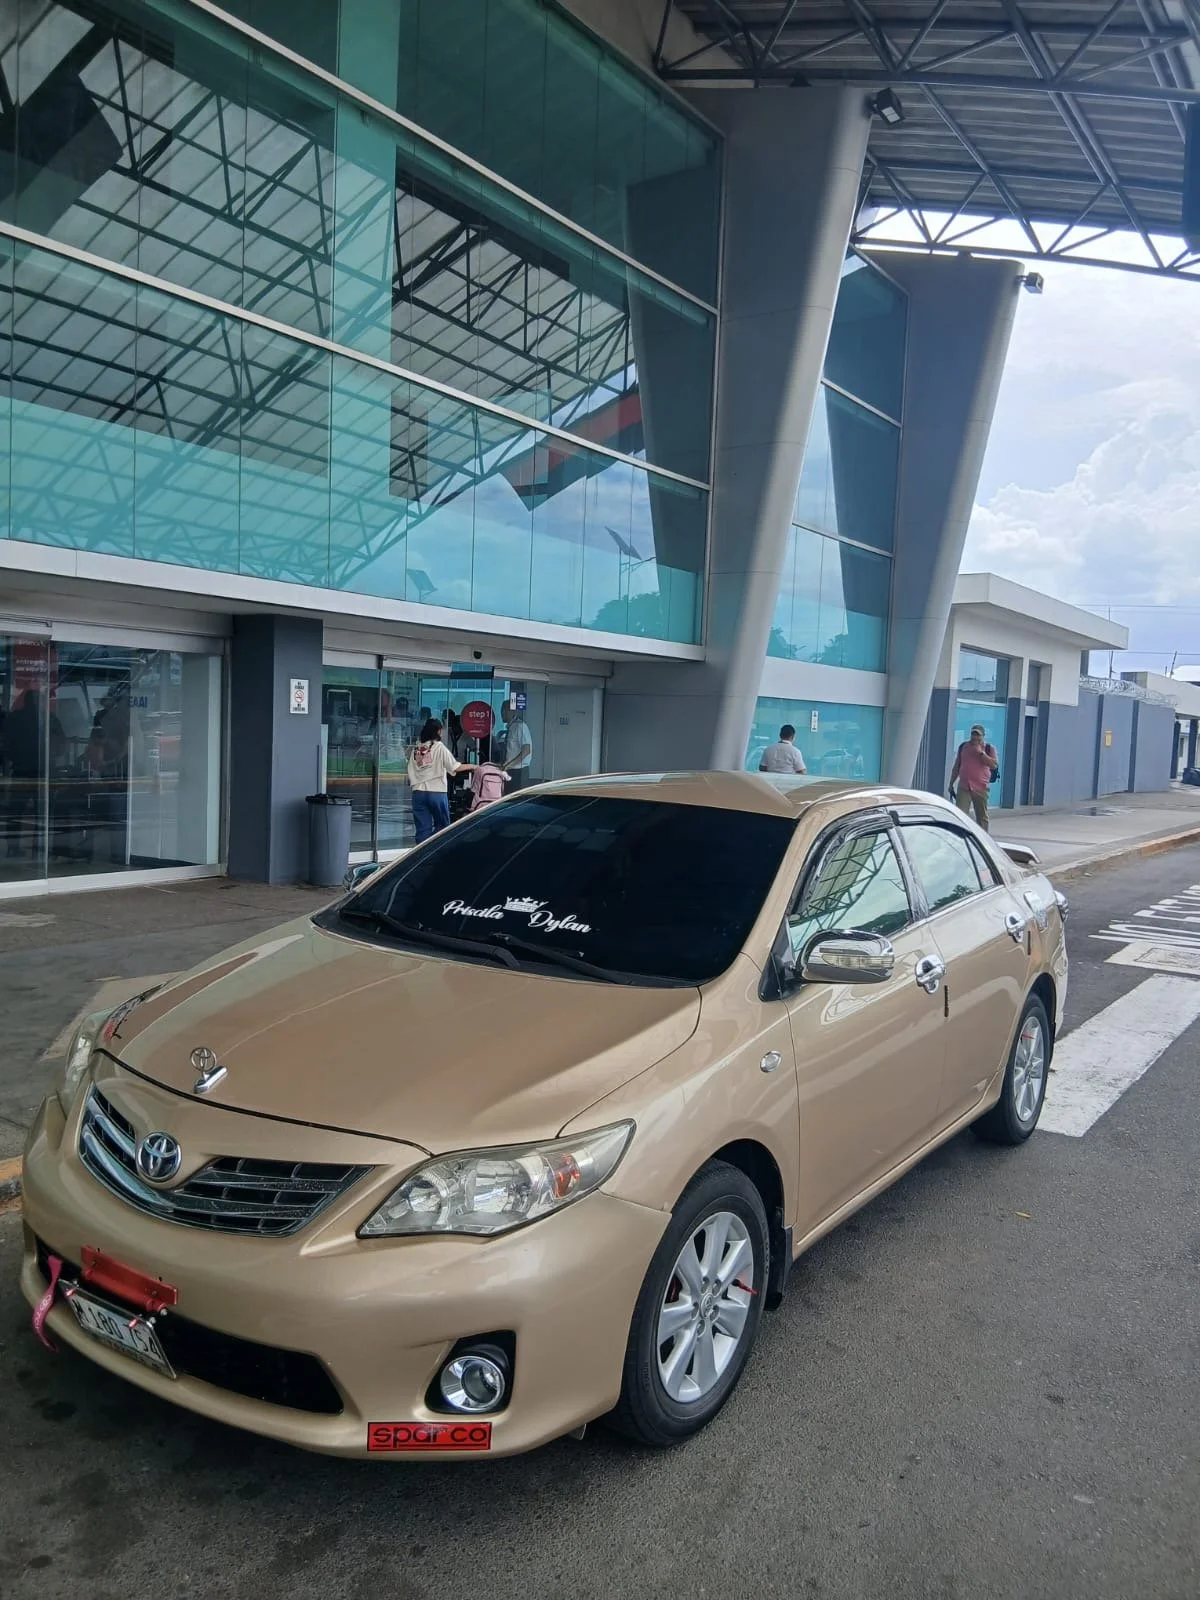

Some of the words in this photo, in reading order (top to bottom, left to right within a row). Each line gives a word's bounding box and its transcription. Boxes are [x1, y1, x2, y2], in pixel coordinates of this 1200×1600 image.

[469, 711, 486, 719] step
[528, 911, 591, 933] Dylan
[373, 1427, 487, 1448] sparco
